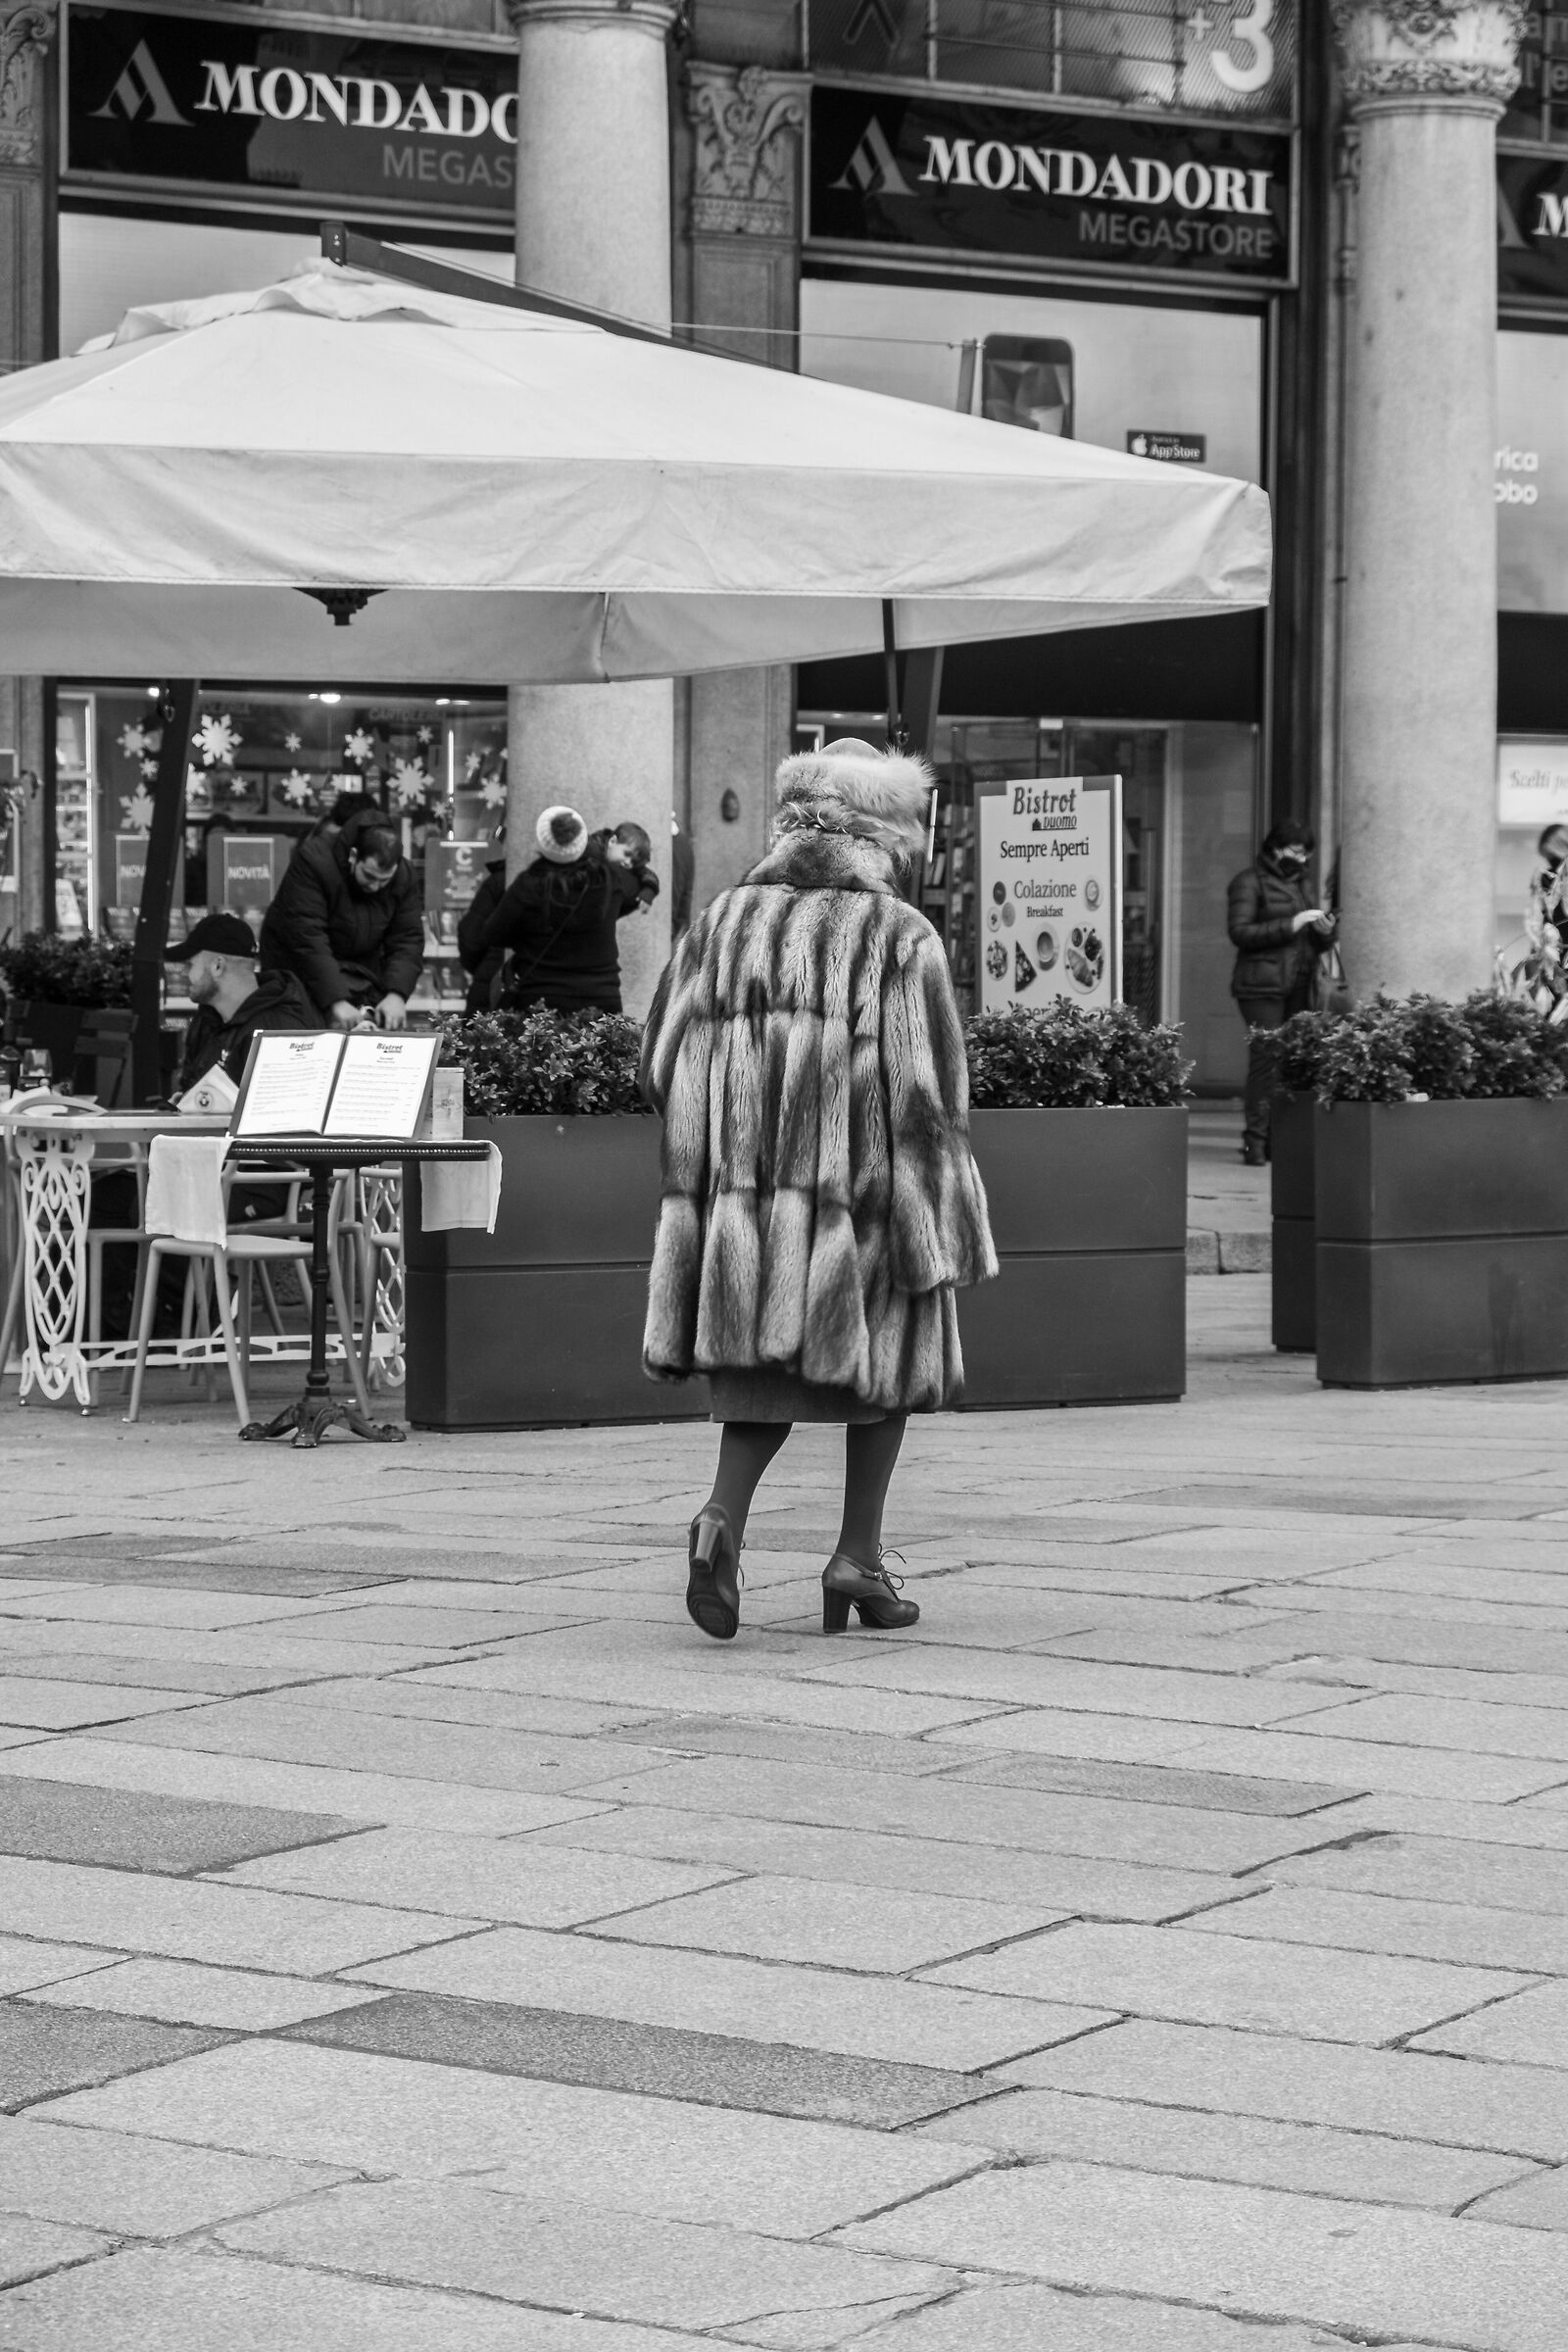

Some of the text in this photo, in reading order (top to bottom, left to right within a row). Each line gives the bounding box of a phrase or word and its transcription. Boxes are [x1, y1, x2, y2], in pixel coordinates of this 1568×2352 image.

[192, 59, 519, 145] MONDADO
[382, 144, 514, 189] MEGAS
[916, 134, 1274, 216] MONDADORI
[1079, 210, 1274, 259] MEGASTORE
[1151, 443, 1201, 460] App Store
[1494, 444, 1540, 472] rica
[1012, 786, 1077, 815] Bistrot
[1000, 837, 1090, 862] Sempre Aperti
[120, 864, 145, 878] NOV
[227, 863, 270, 879] NOVITÀ
[1013, 879, 1077, 900] Colazione
[1026, 906, 1064, 918] Breakfast
